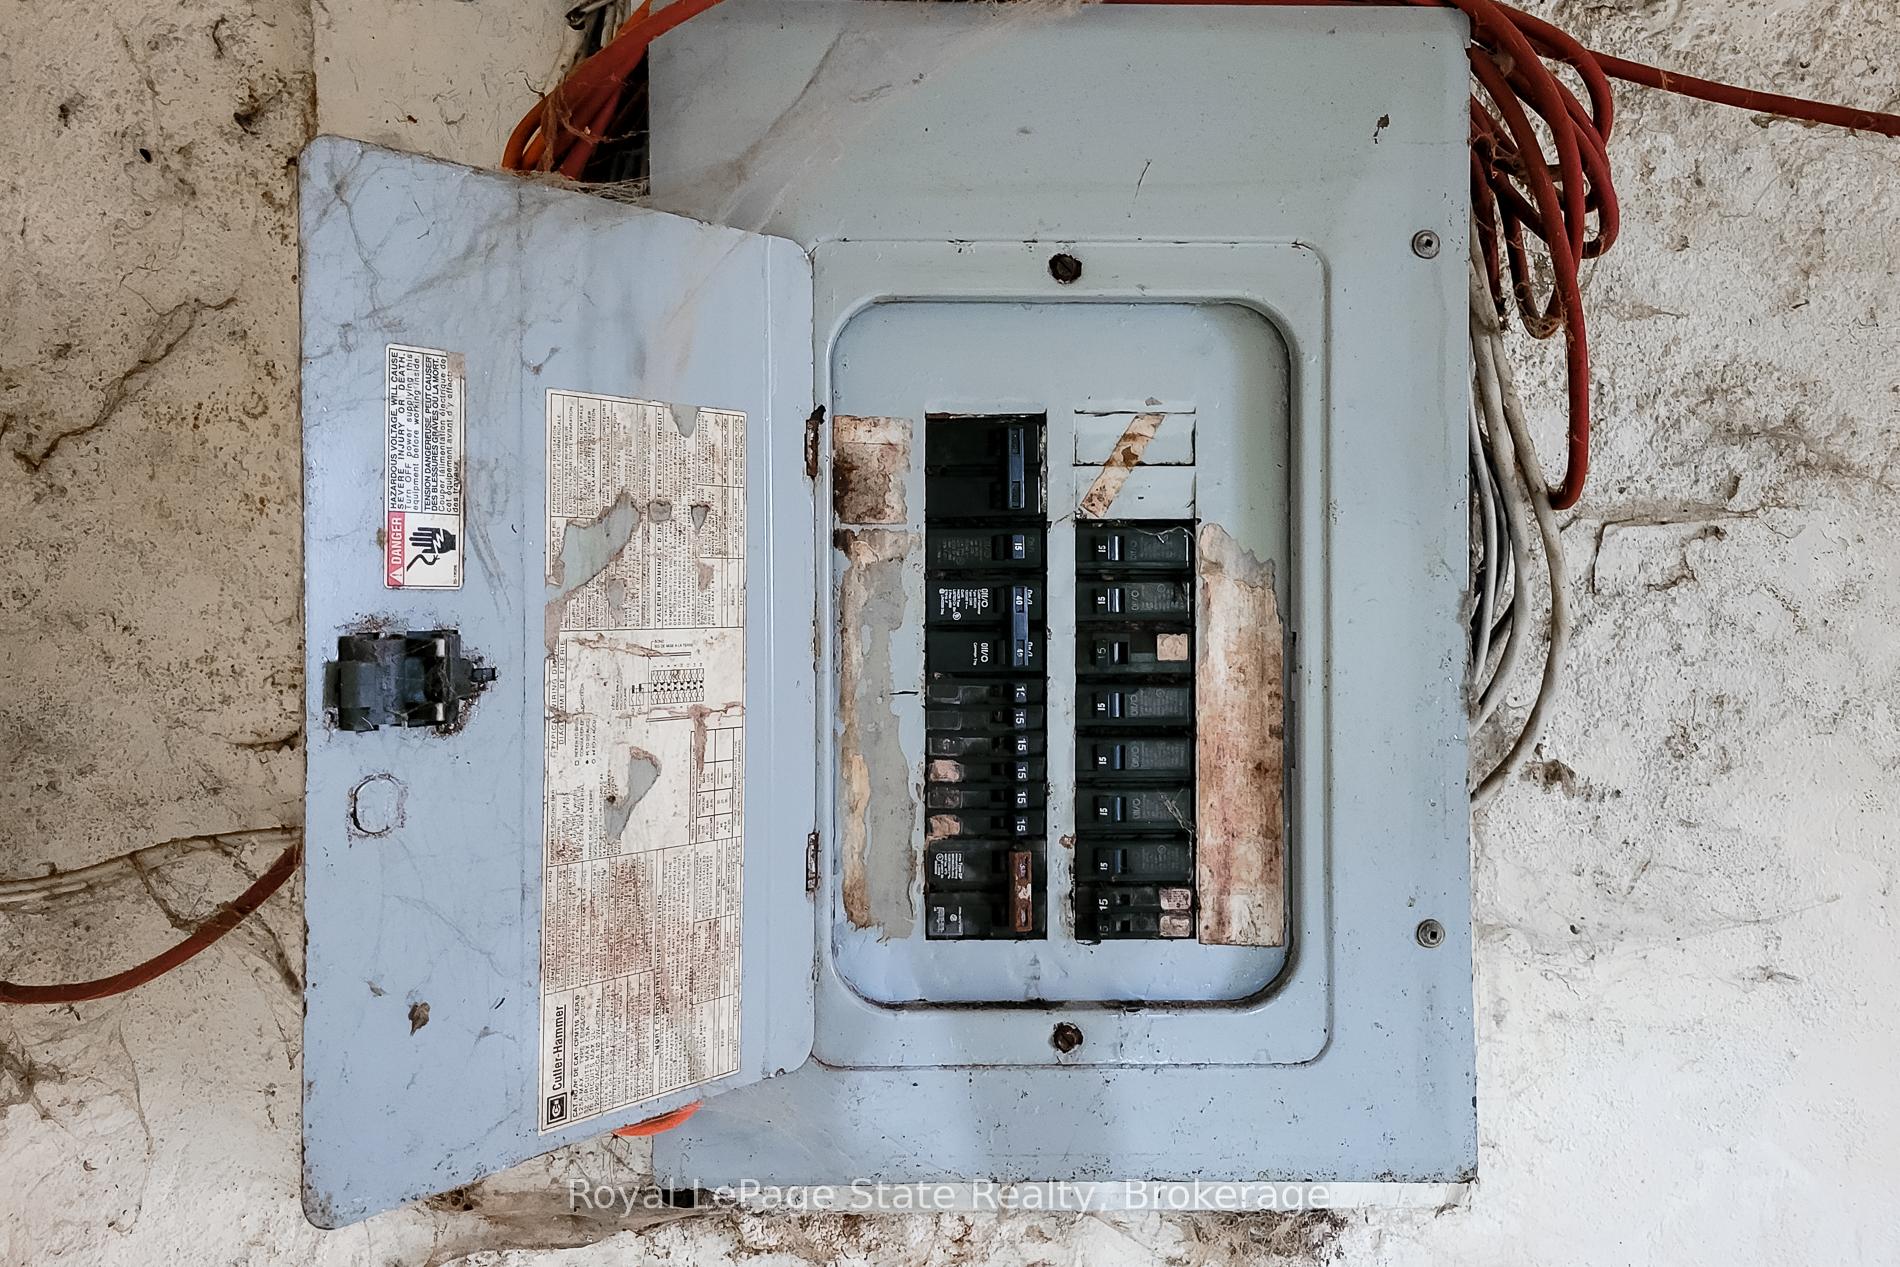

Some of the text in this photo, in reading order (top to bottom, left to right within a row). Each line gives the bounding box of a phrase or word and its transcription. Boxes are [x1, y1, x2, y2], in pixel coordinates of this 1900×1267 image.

[440, 358, 446, 370] de
[398, 353, 406, 390] DEATH.
[432, 385, 439, 394] LA
[406, 377, 414, 422] supplying
[432, 397, 438, 408] OU
[398, 400, 405, 414] OR
[413, 390, 421, 424] working
[657, 479, 662, 489] EN
[391, 517, 402, 564] DANGER
[1098, 545, 1106, 553] 15
[1016, 595, 1023, 605] 40
[1098, 596, 1106, 604] 15
[560, 678, 564, 688] DE
[1098, 702, 1106, 711] 15
[1016, 712, 1024, 724] 15
[1018, 738, 1027, 751] 15
[1099, 756, 1107, 764] 15
[1018, 767, 1027, 779] 15
[1017, 792, 1026, 803] 15
[1100, 807, 1108, 816] 15
[1017, 820, 1025, 832] 15
[1100, 862, 1108, 870] 15
[1099, 898, 1108, 911] 15
